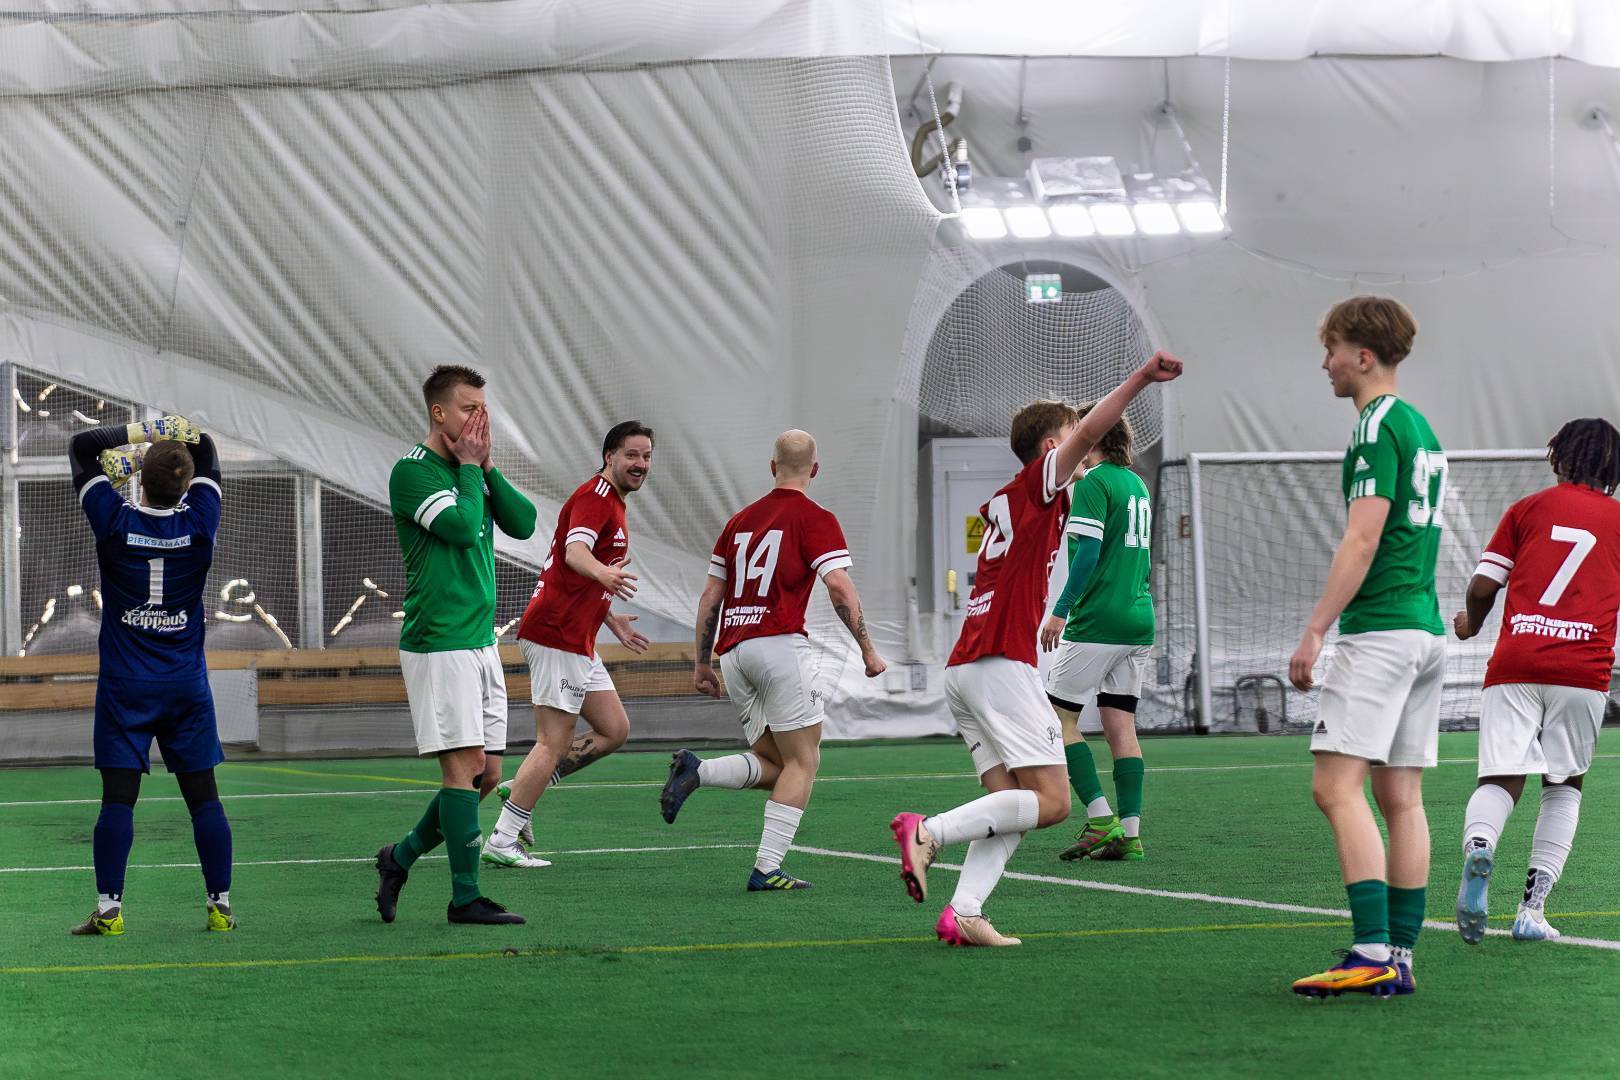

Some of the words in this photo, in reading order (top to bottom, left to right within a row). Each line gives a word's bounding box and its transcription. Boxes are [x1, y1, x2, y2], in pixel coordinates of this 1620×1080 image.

[1408, 448, 1448, 527] 97
[1125, 495, 1152, 549] 10
[147, 557, 164, 605] 1
[734, 530, 783, 598] 14
[1538, 524, 1597, 607] 7
